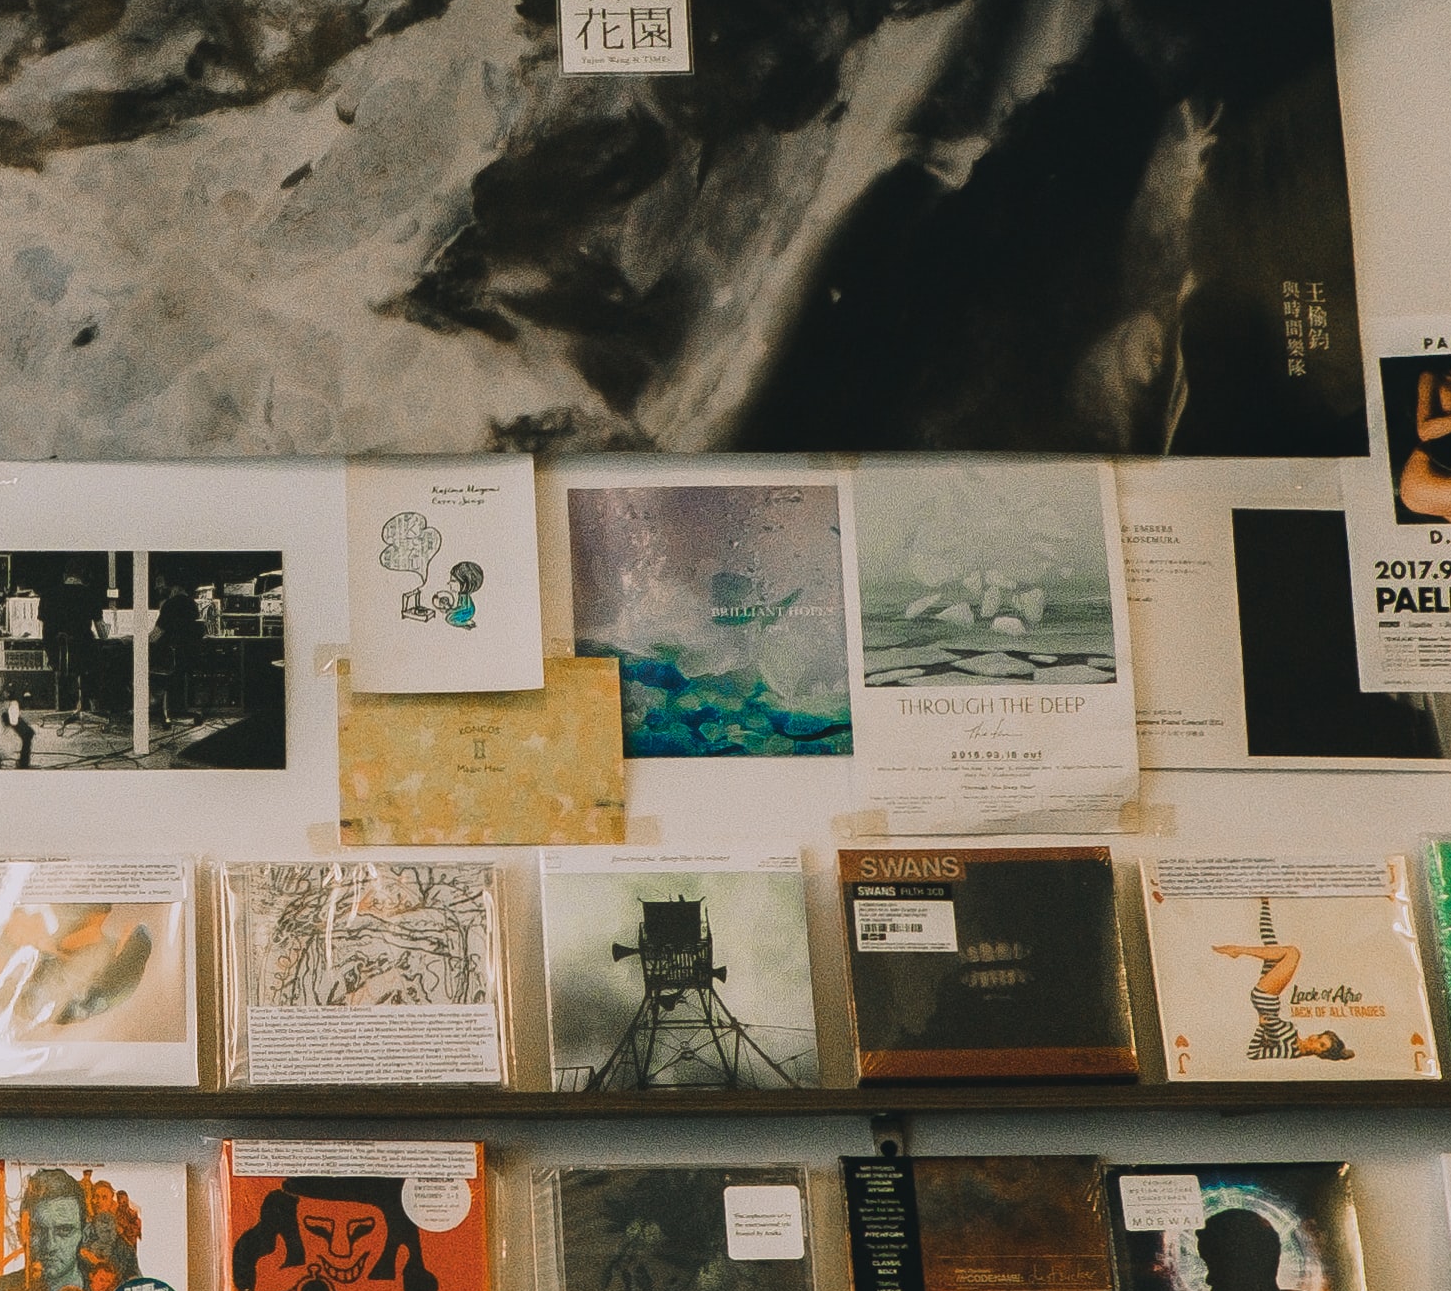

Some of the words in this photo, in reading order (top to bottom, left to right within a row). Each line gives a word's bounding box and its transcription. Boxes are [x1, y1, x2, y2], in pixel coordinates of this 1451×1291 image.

[574, 6, 673, 51] 花園
[711, 605, 784, 618] BRILLIANT
[897, 697, 994, 716] THROUGH
[1000, 696, 1034, 714] THE
[1040, 696, 1086, 714] DEEP
[1023, 750, 1043, 759] out
[860, 856, 960, 879] SWANS
[857, 885, 897, 897] SWANS
[1290, 984, 1320, 1005] Lack
[1331, 984, 1363, 1006] Afro
[1349, 1005, 1386, 1018] TRADES
[1132, 1217, 1201, 1227] MOGWAI
